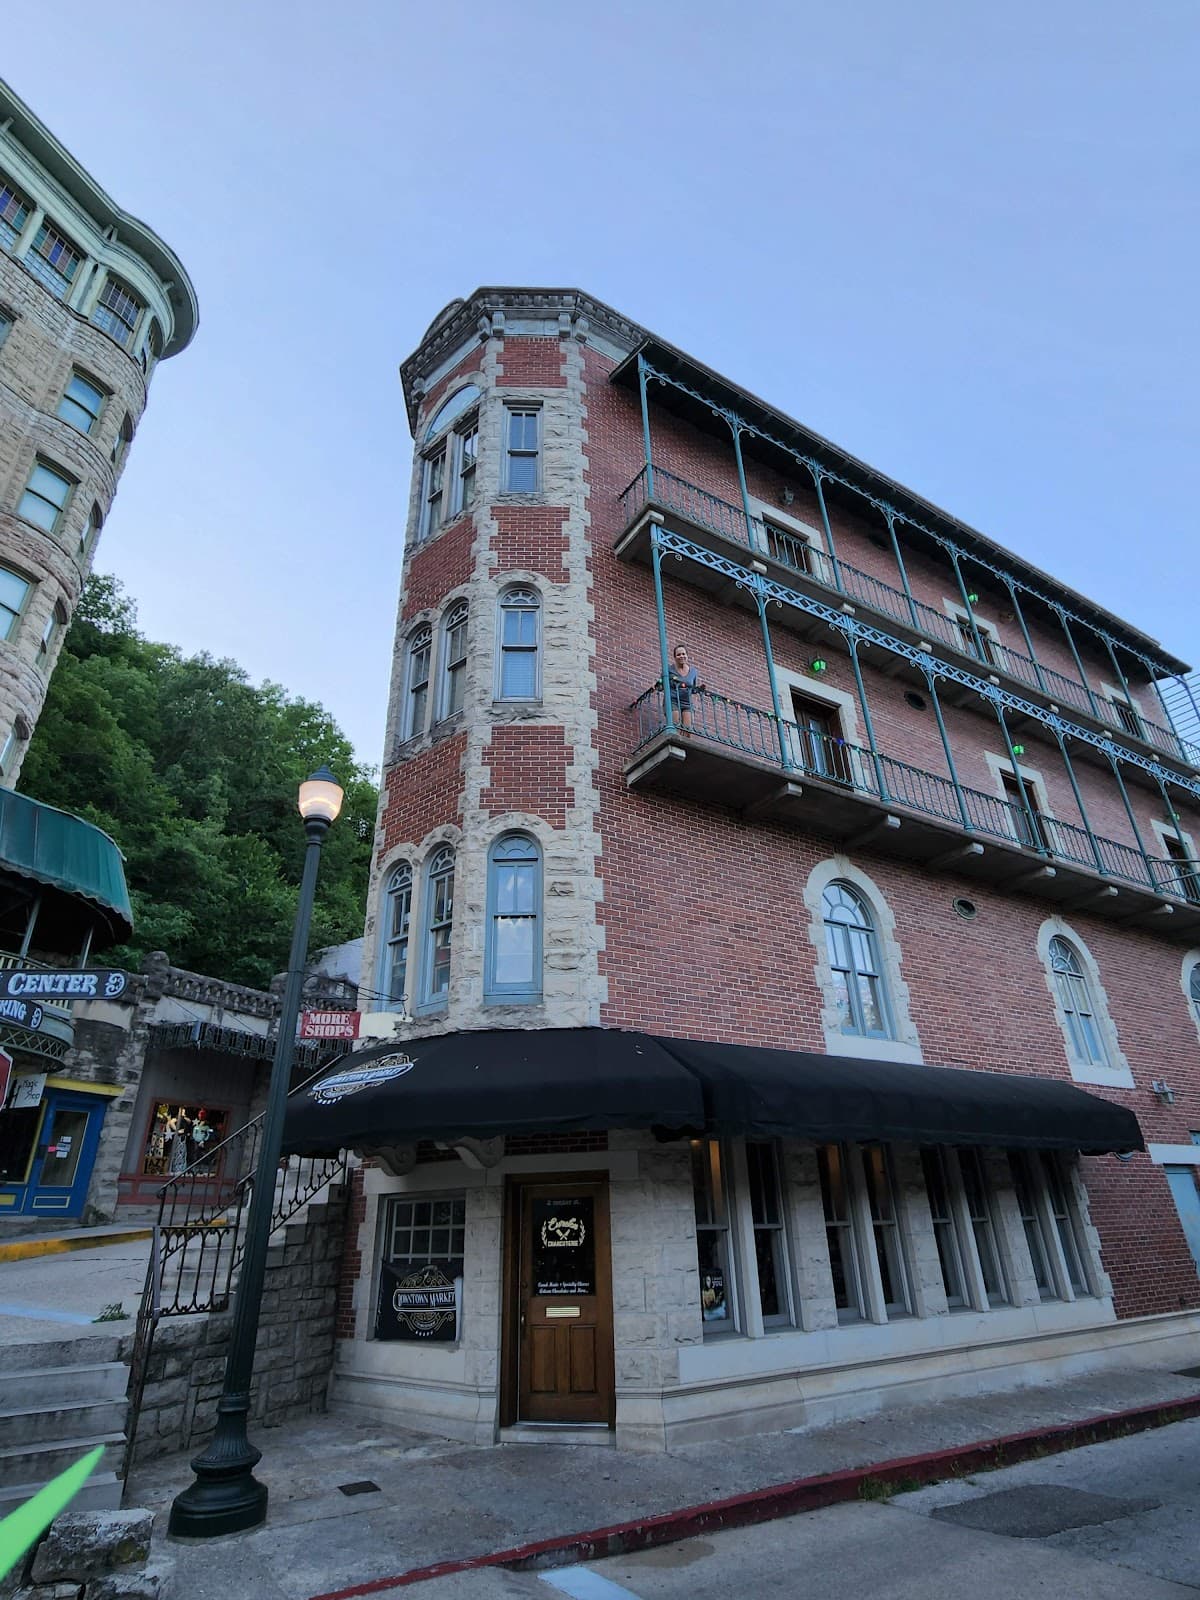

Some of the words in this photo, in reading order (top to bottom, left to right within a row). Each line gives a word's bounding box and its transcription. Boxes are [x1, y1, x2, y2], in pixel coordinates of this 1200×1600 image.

[7, 973, 99, 996] CENTER
[309, 1013, 350, 1025] MORE
[304, 1025, 354, 1037] SHOPS
[397, 1293, 429, 1307] DOWNTOWN
